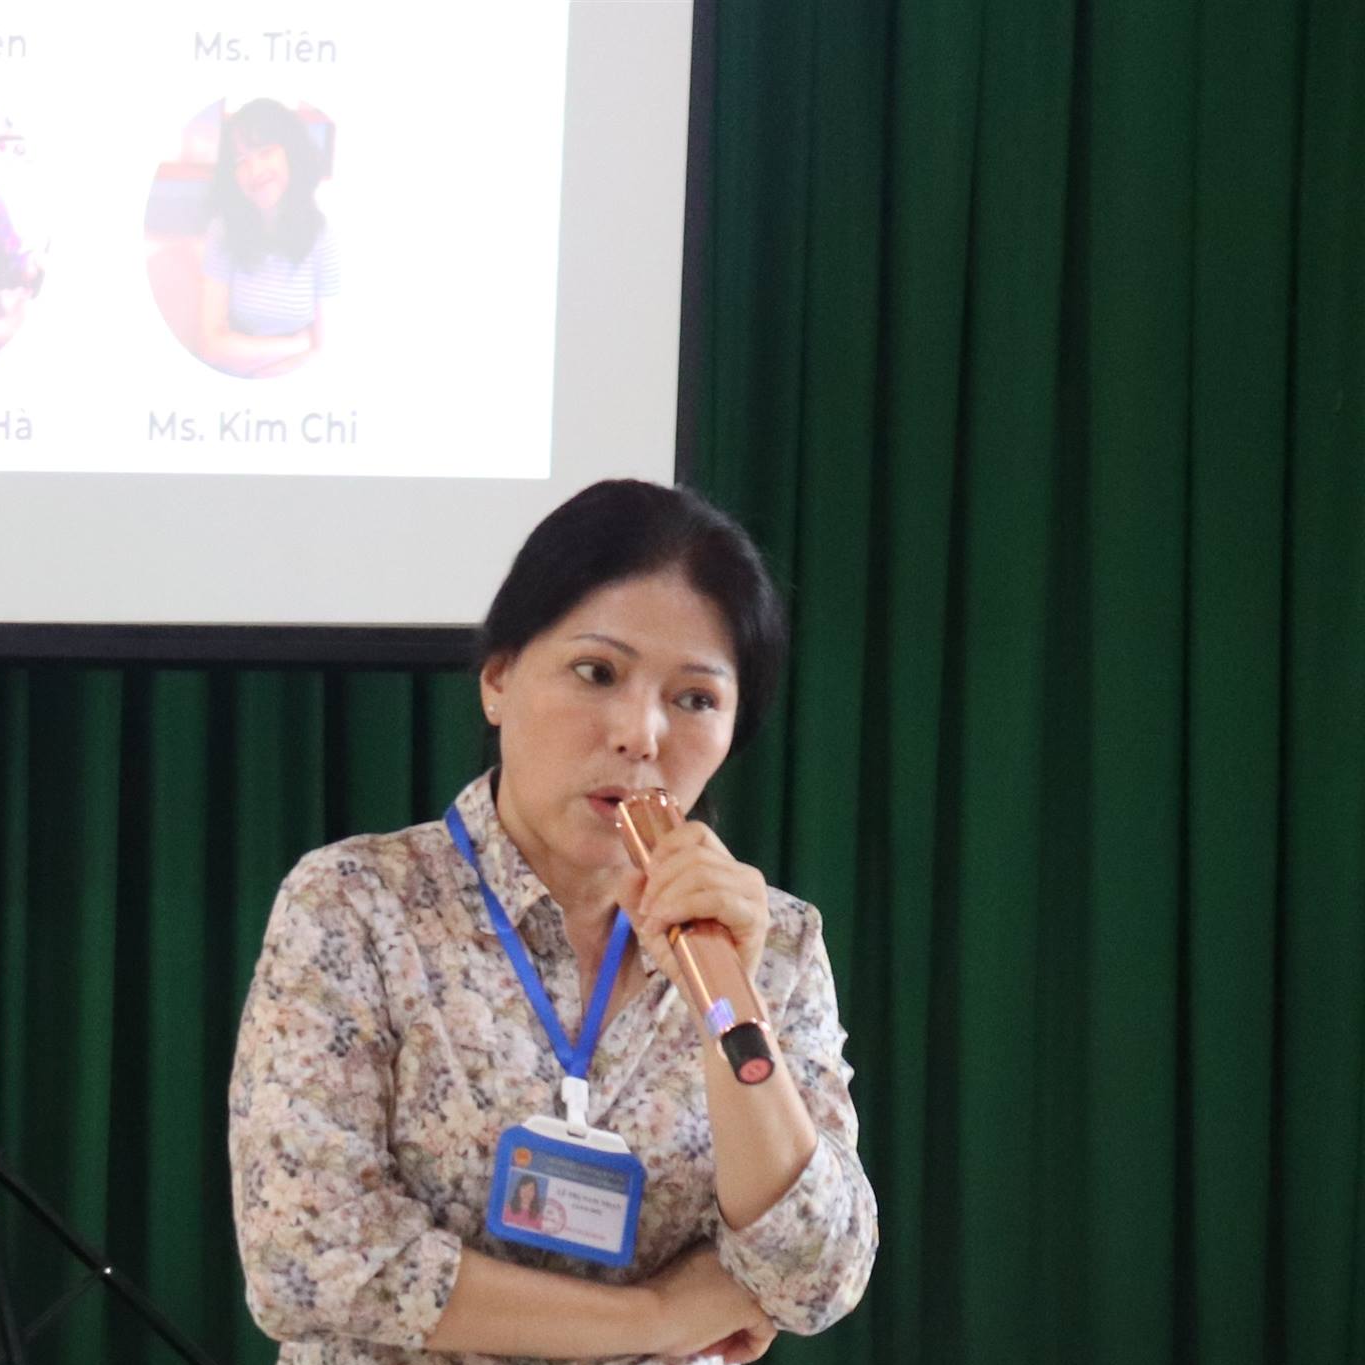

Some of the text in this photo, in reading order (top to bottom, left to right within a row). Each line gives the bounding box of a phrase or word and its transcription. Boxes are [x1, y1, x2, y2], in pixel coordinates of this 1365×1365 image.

[194, 29, 337, 63] Ms. Tiên
[148, 408, 358, 444] Ms. Kim Chi
